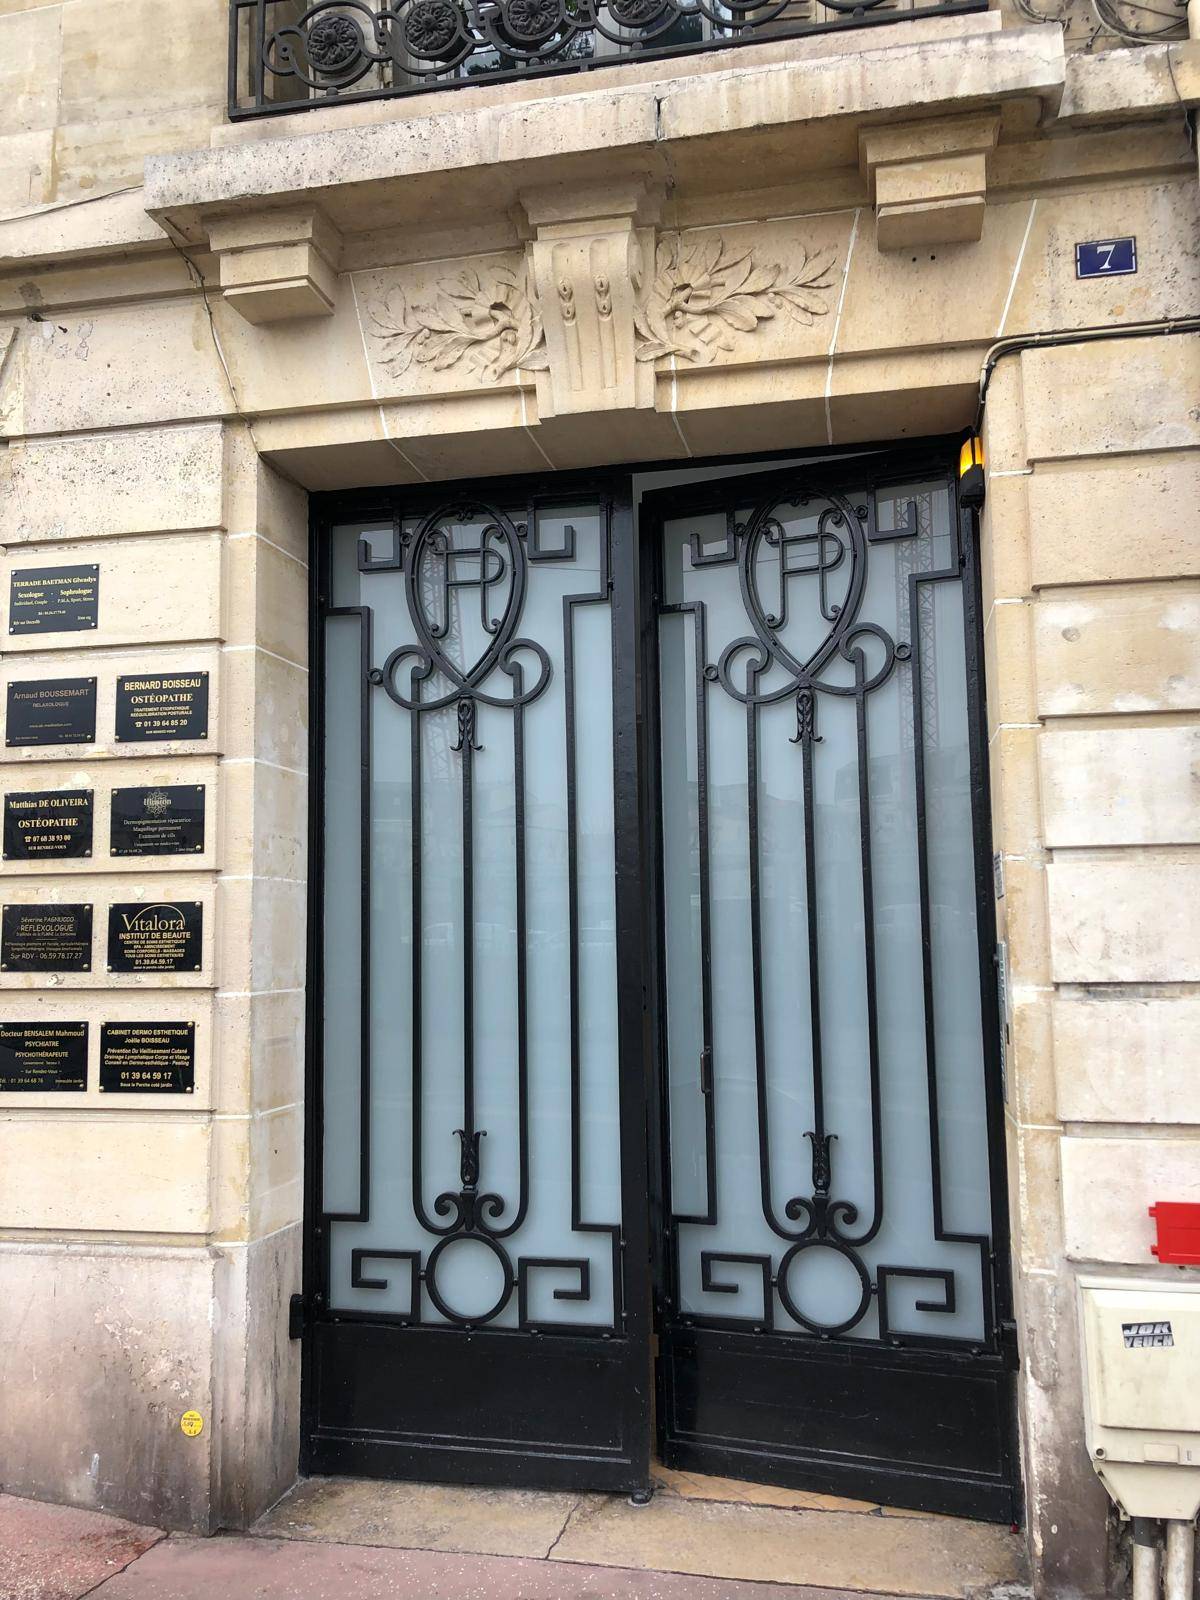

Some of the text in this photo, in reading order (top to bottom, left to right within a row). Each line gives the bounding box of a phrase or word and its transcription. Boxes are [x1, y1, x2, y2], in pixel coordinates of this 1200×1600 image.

[1097, 244, 1115, 270] 7
[125, 679, 200, 690] BERNARD BOISSEAU
[40, 689, 89, 698] BOUSSEMART
[131, 693, 193, 704] OSTÉOPATHE
[51, 799, 88, 807] OLIVEIRA
[18, 818, 78, 828] OSTÉOPATHE
[121, 914, 184, 931] Vitalora
